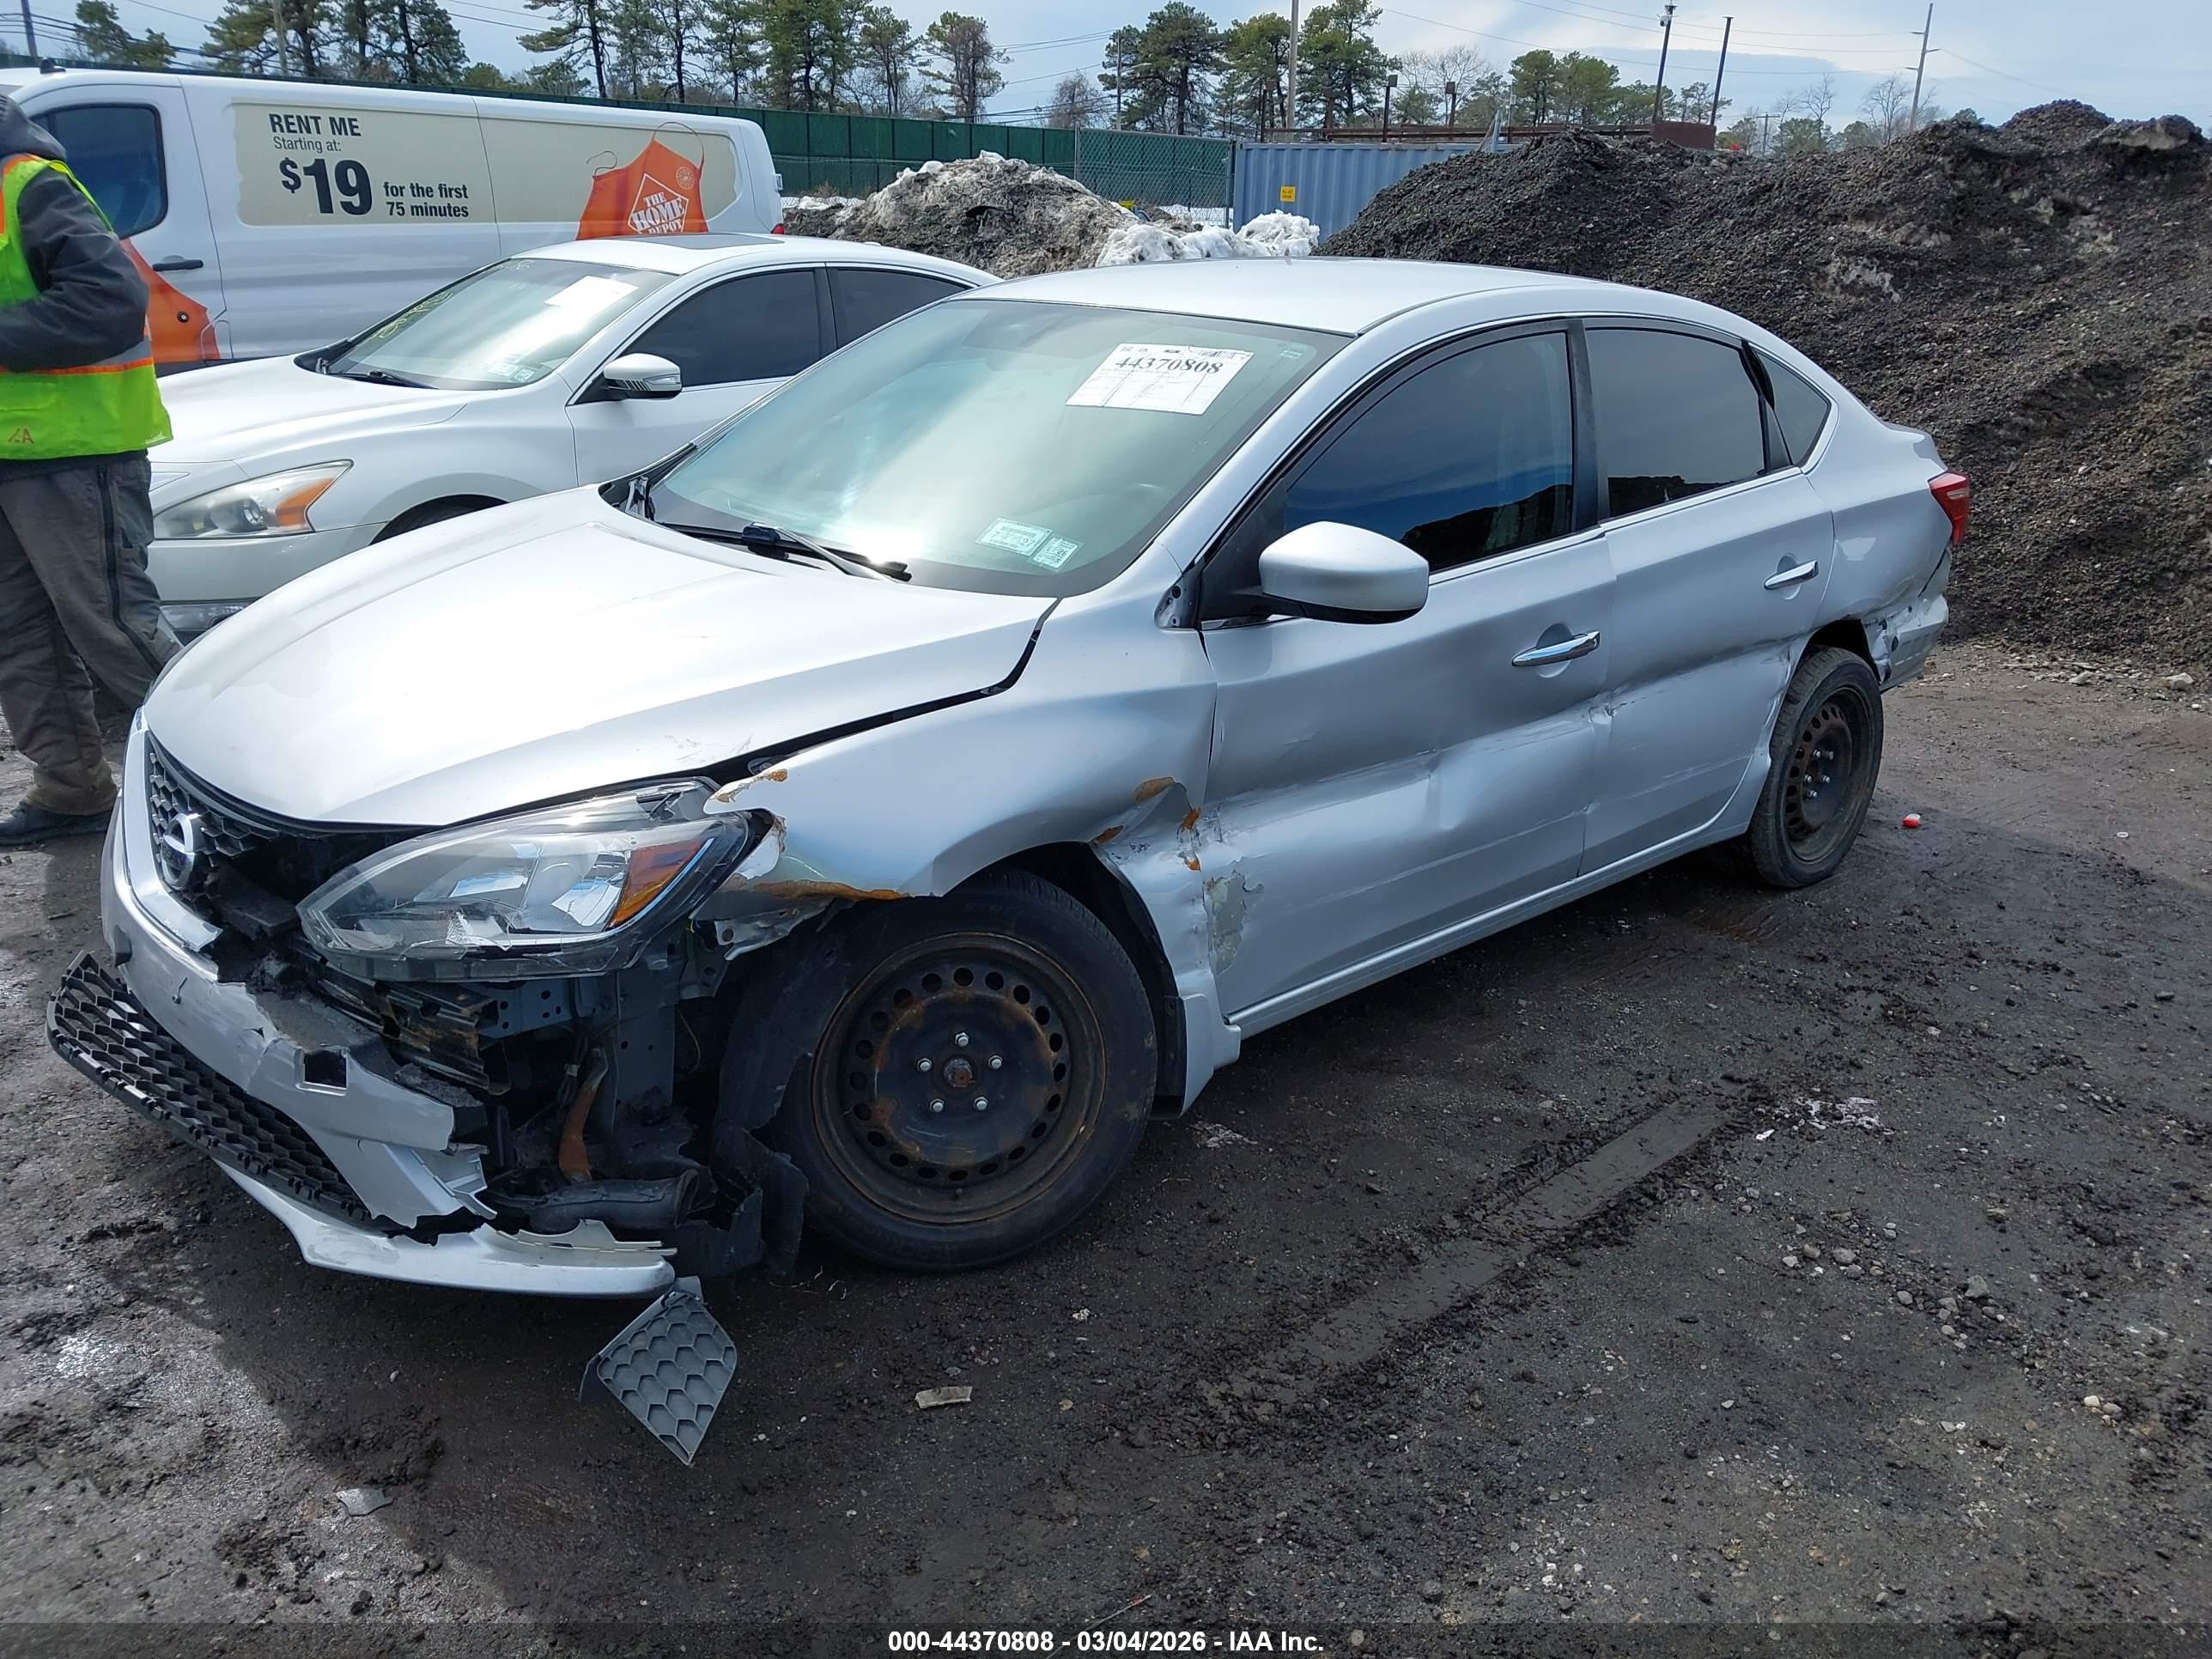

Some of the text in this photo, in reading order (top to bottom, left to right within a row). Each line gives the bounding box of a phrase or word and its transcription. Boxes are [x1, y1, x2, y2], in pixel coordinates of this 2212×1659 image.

[269, 113, 362, 137] RENT ME
[273, 136, 342, 154] Starting at:
[279, 156, 373, 216] $19
[383, 181, 469, 199] for the first
[643, 191, 666, 207] THE
[386, 201, 470, 218] 75 minutes
[632, 197, 685, 231] HOME
[1115, 356, 1224, 374] 44370808
